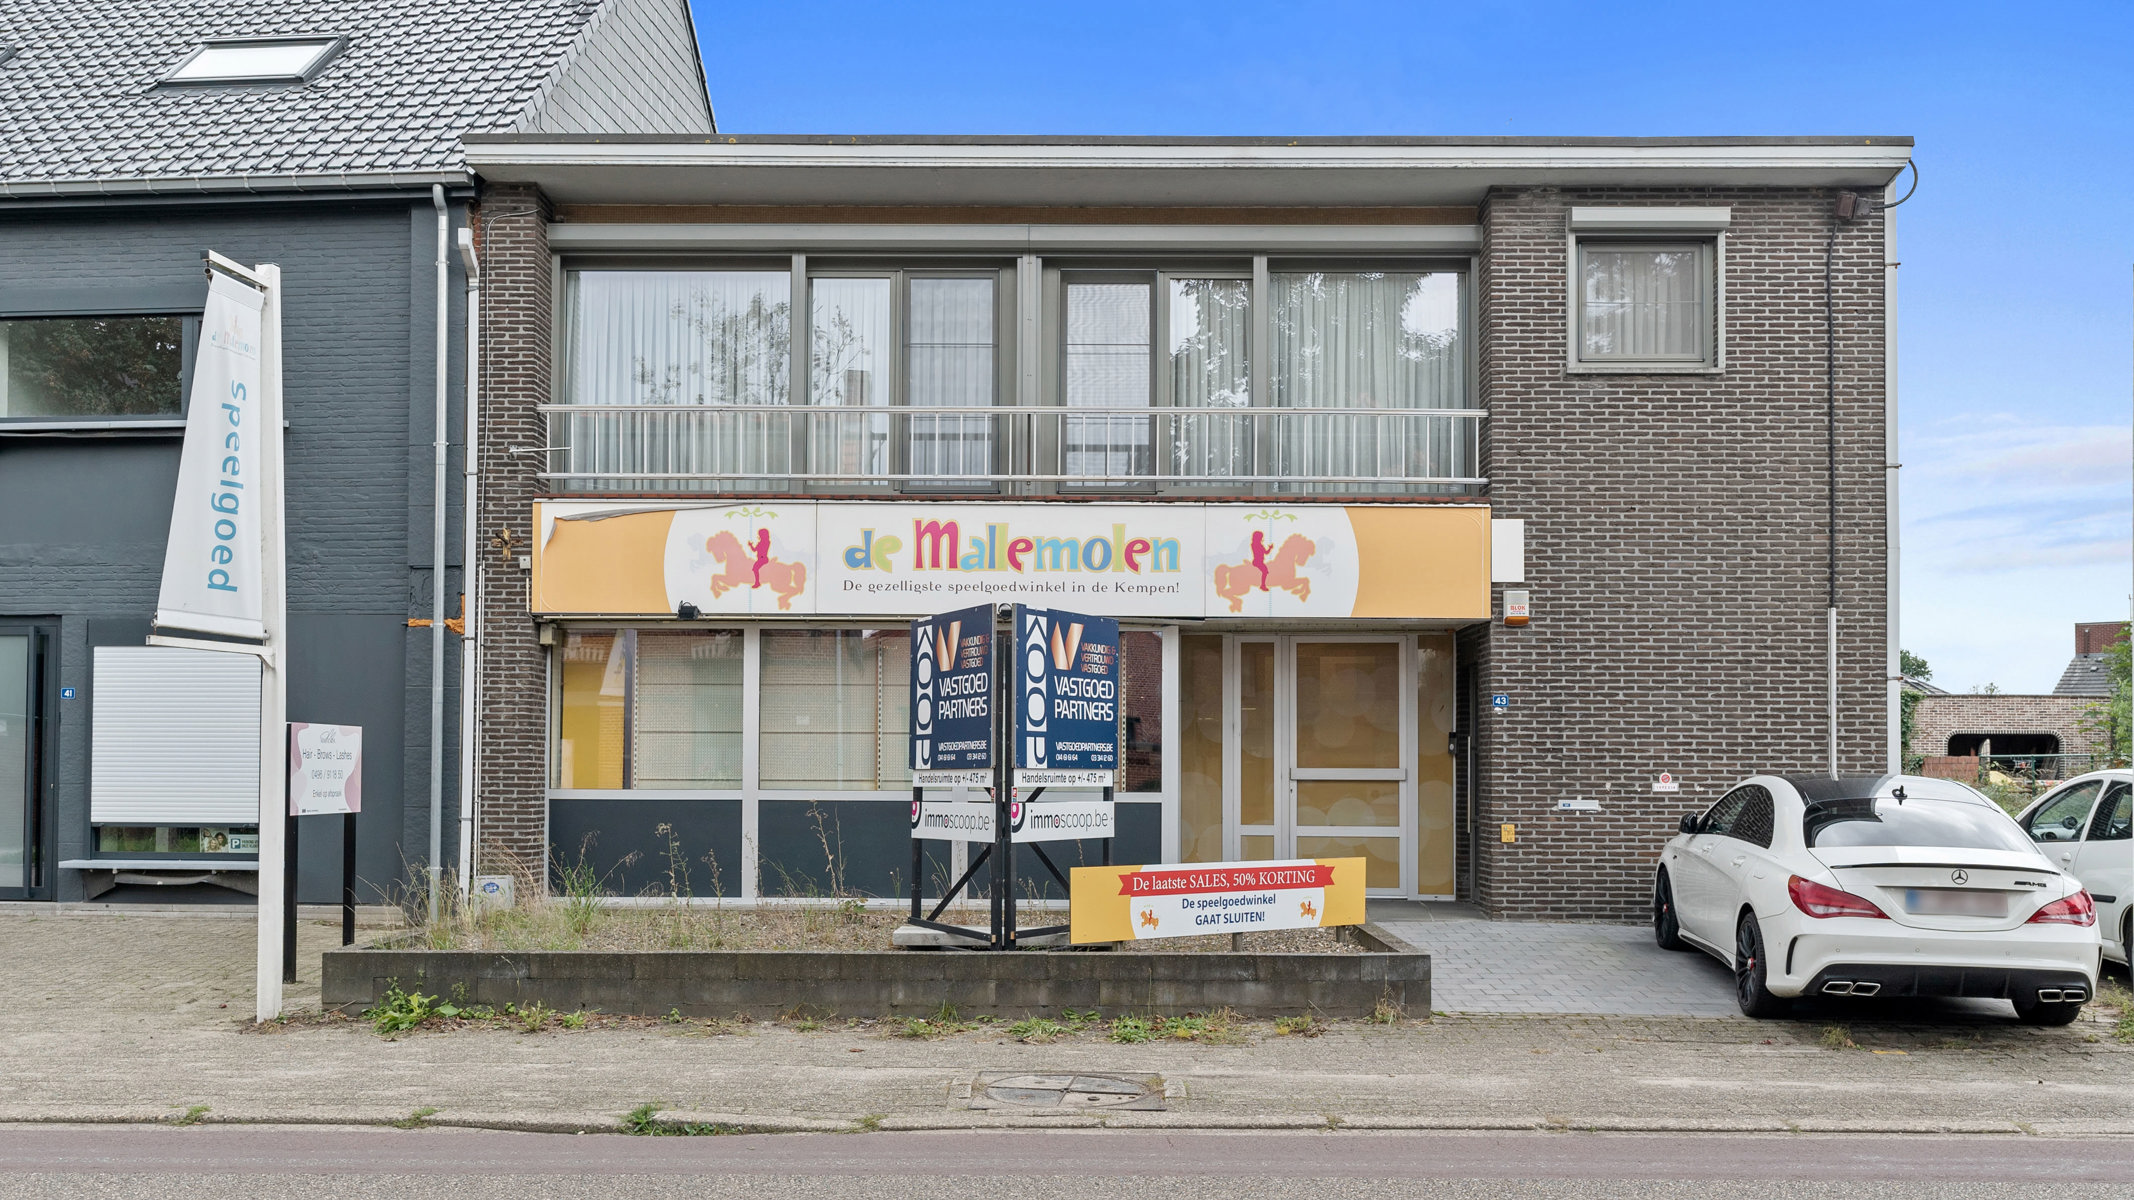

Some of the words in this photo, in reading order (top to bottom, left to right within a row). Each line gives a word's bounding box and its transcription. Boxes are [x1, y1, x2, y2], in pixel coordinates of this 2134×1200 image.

[208, 379, 247, 593] speelgoed
[843, 527, 903, 574] de
[843, 580, 865, 592] De
[868, 579, 942, 594] gezelligste
[948, 580, 1066, 595] speelgoedwinkel
[1072, 581, 1086, 593] in
[1091, 581, 1109, 593] de
[1114, 581, 1180, 595] Kempen!
[1081, 663, 1109, 675] VASTGOED
[64, 689, 73, 697] 41
[938, 672, 988, 697] VASTGOED
[1054, 675, 1115, 699] VASTGOED
[938, 696, 988, 720] PARTNERS
[1054, 698, 1114, 721] PARTNERS
[1495, 697, 1506, 705] 43
[302, 748, 313, 760] Hair
[317, 748, 332, 760] Brows
[336, 749, 352, 760] Lashes
[918, 772, 953, 784] Handelsruimte
[954, 775, 961, 785] op
[969, 772, 979, 783] 475
[1021, 772, 1067, 784] Handelsruimte
[1068, 774, 1076, 785] op
[1086, 772, 1097, 783] 475
[924, 808, 990, 834] immoscoop.be
[1030, 808, 1108, 832] immoscoop.be
[1132, 877, 1150, 891] De
[1152, 875, 1187, 890] laatste
[1189, 873, 1230, 889] SALES,
[1233, 872, 1256, 887] 50%
[1258, 869, 1316, 885] KORTING
[1182, 898, 1195, 909] De
[1197, 894, 1276, 911] speelgoedwinkel
[1195, 914, 1221, 926] GAAT
[1223, 911, 1266, 925] SLUITEN!
